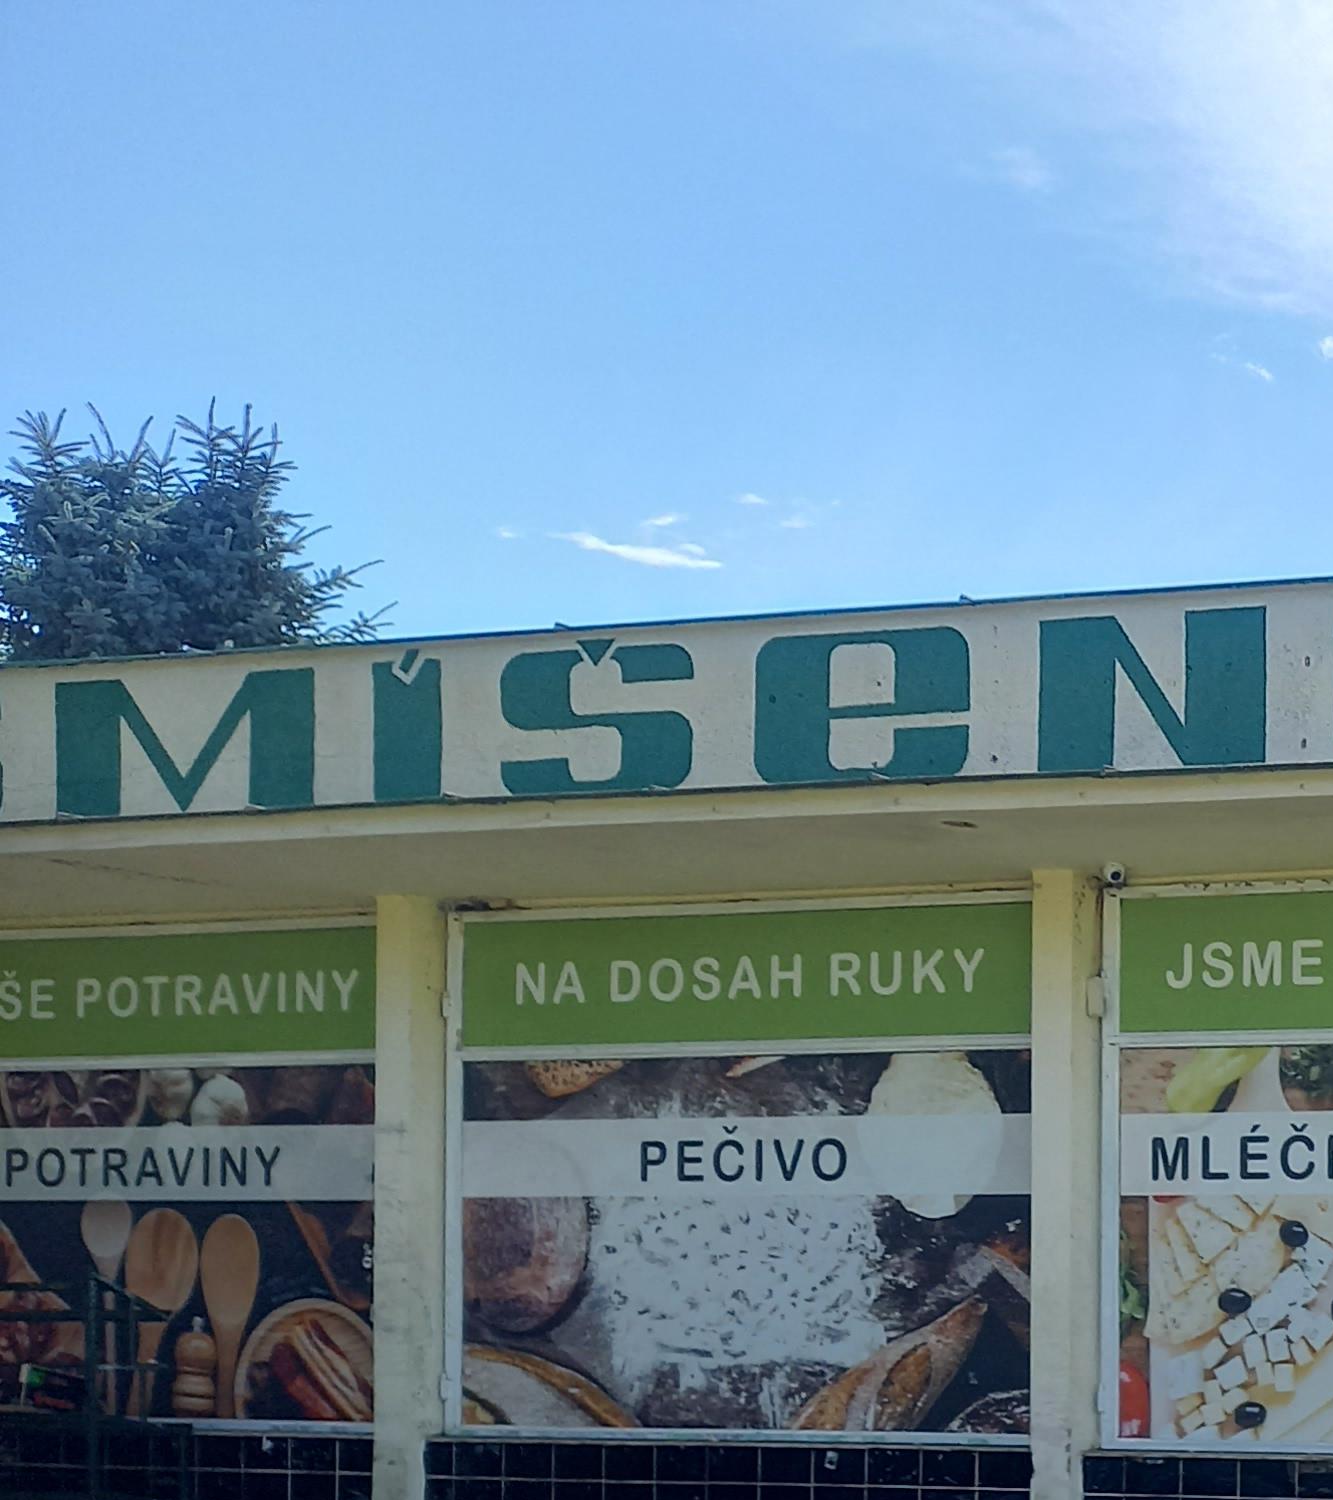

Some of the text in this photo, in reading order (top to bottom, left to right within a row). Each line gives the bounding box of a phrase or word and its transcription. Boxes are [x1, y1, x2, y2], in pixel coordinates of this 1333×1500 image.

[515, 948, 986, 1004] NA DOSAH RUKY
[1166, 938, 1325, 988] JSME
[76, 969, 360, 1018] POTRAVINY
[5, 1146, 281, 1187] POTRAVINY
[639, 1126, 848, 1182] PEČIVO
